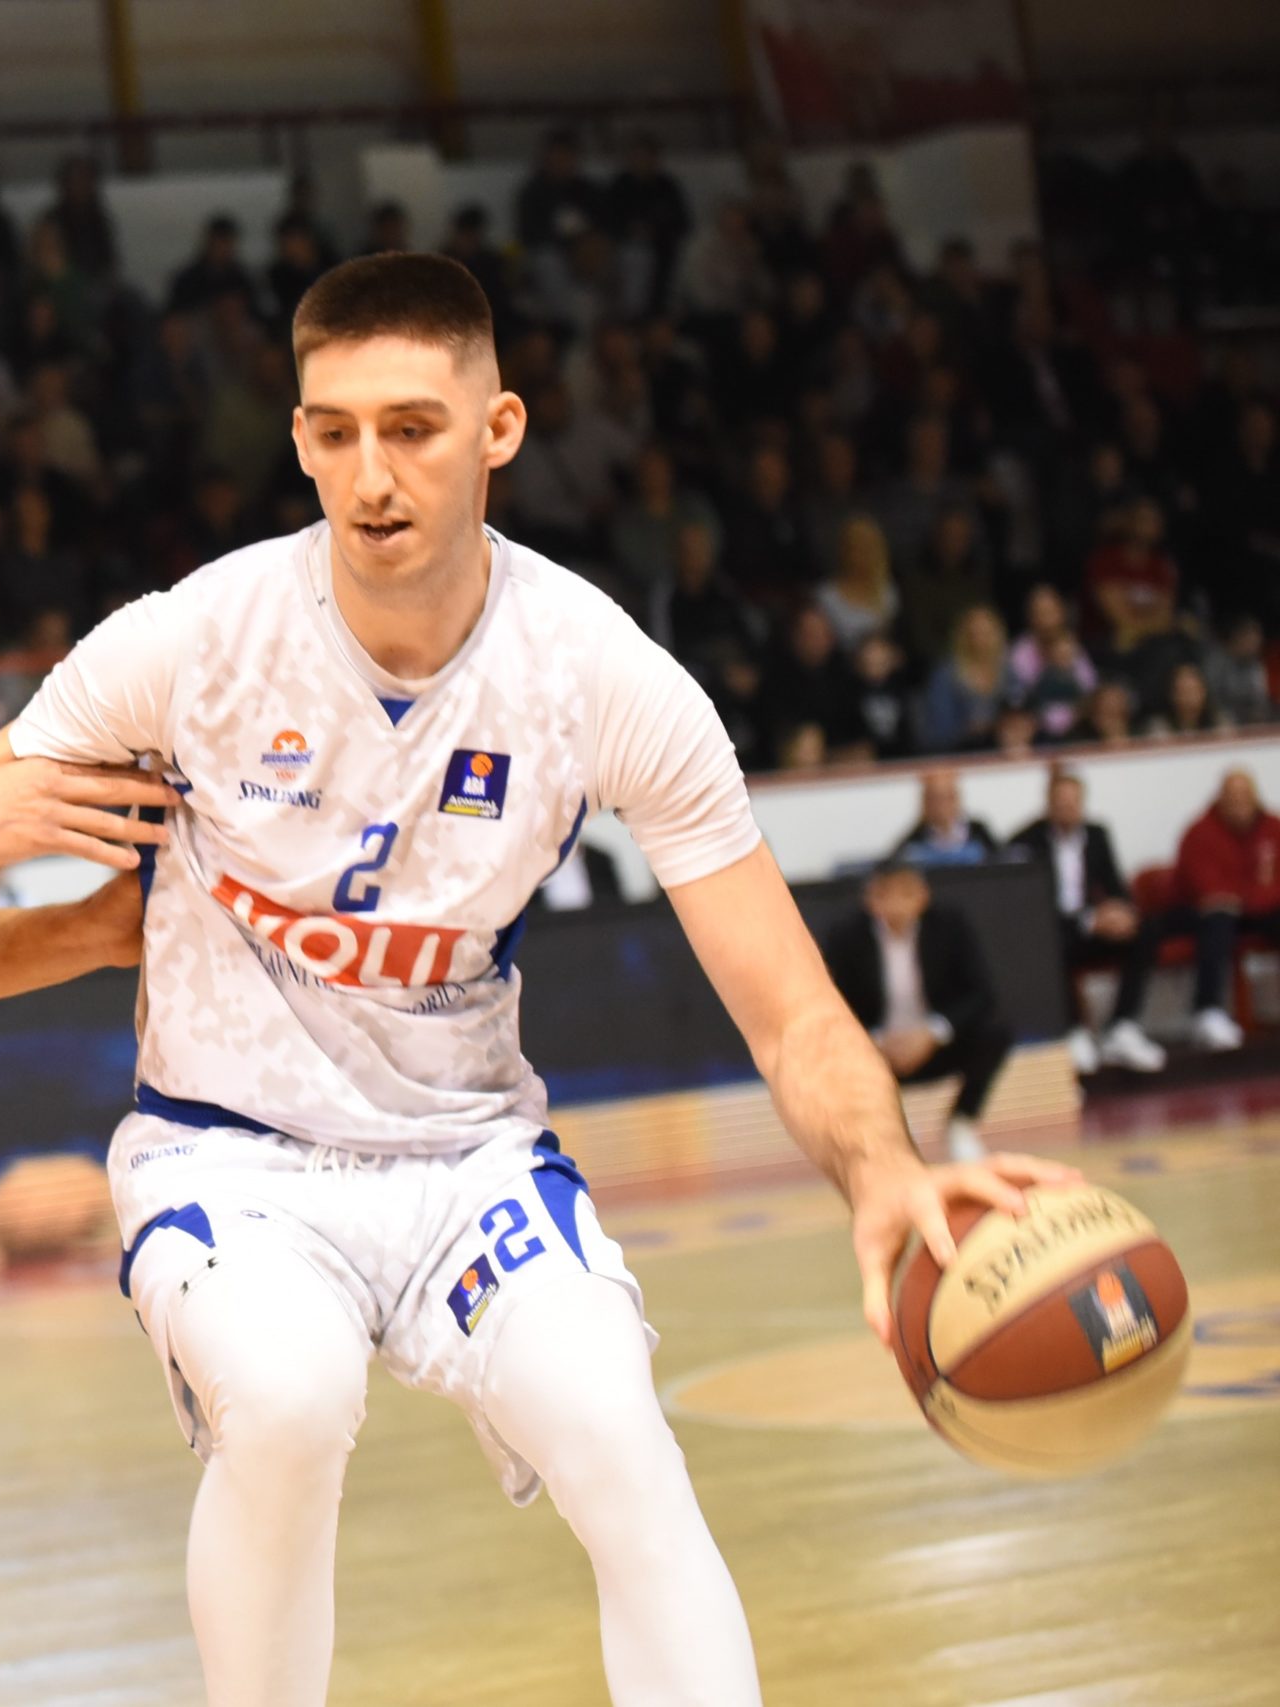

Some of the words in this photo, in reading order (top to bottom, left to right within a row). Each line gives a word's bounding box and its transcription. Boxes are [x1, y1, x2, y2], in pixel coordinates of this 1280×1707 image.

[238, 779, 322, 810] SPALDING
[332, 822, 398, 912] 2
[480, 1199, 546, 1272] 2
